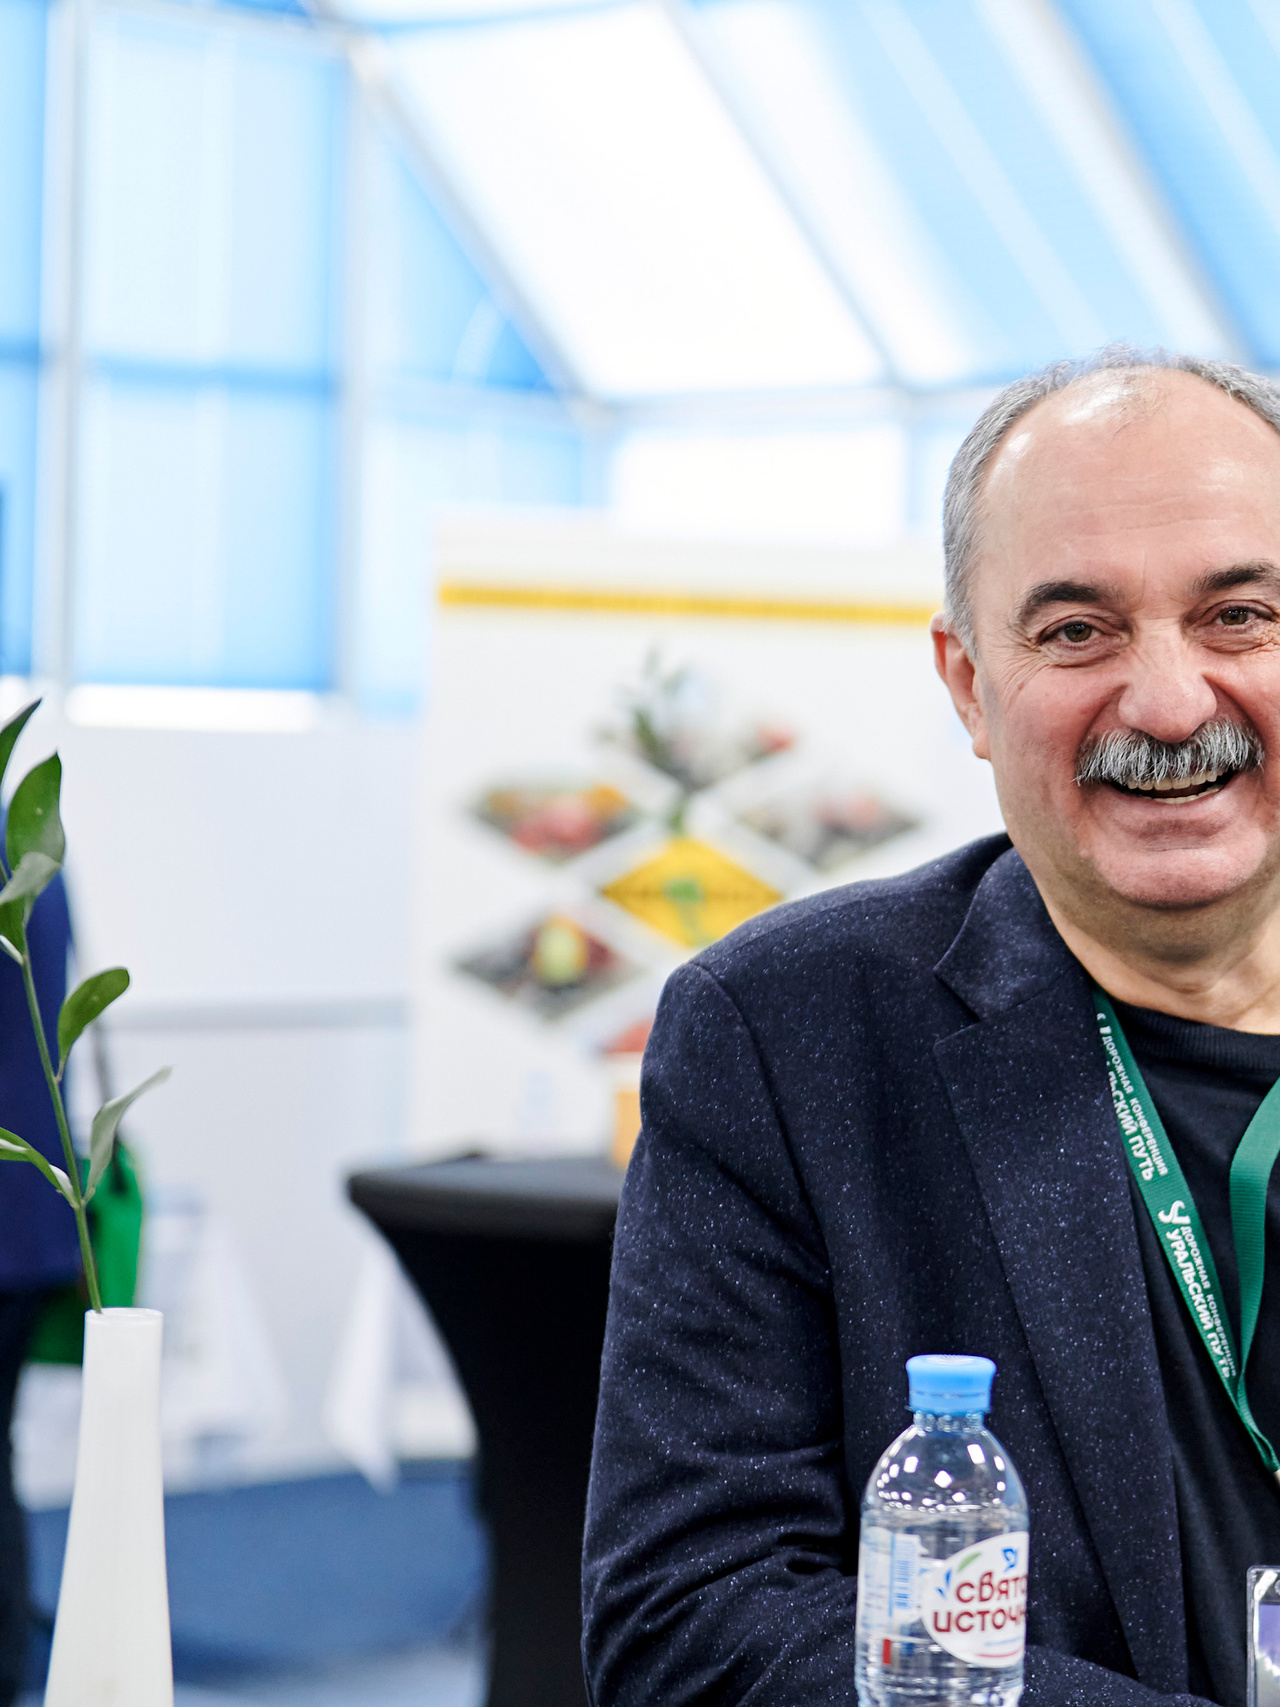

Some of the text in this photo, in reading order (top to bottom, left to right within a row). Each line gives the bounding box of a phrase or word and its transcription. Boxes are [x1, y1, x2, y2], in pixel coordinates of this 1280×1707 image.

[1102, 1035, 1134, 1094] ДОРОЖНАЯ
[1129, 1097, 1168, 1176] КОНФЕРЕНЦИЯ
[1128, 1134, 1155, 1181] ПУТЬ
[1165, 1228, 1230, 1378] УРАЛЬСКИЙ ПУТЬ
[1180, 1226, 1211, 1289] ДОРОЖНАЯ
